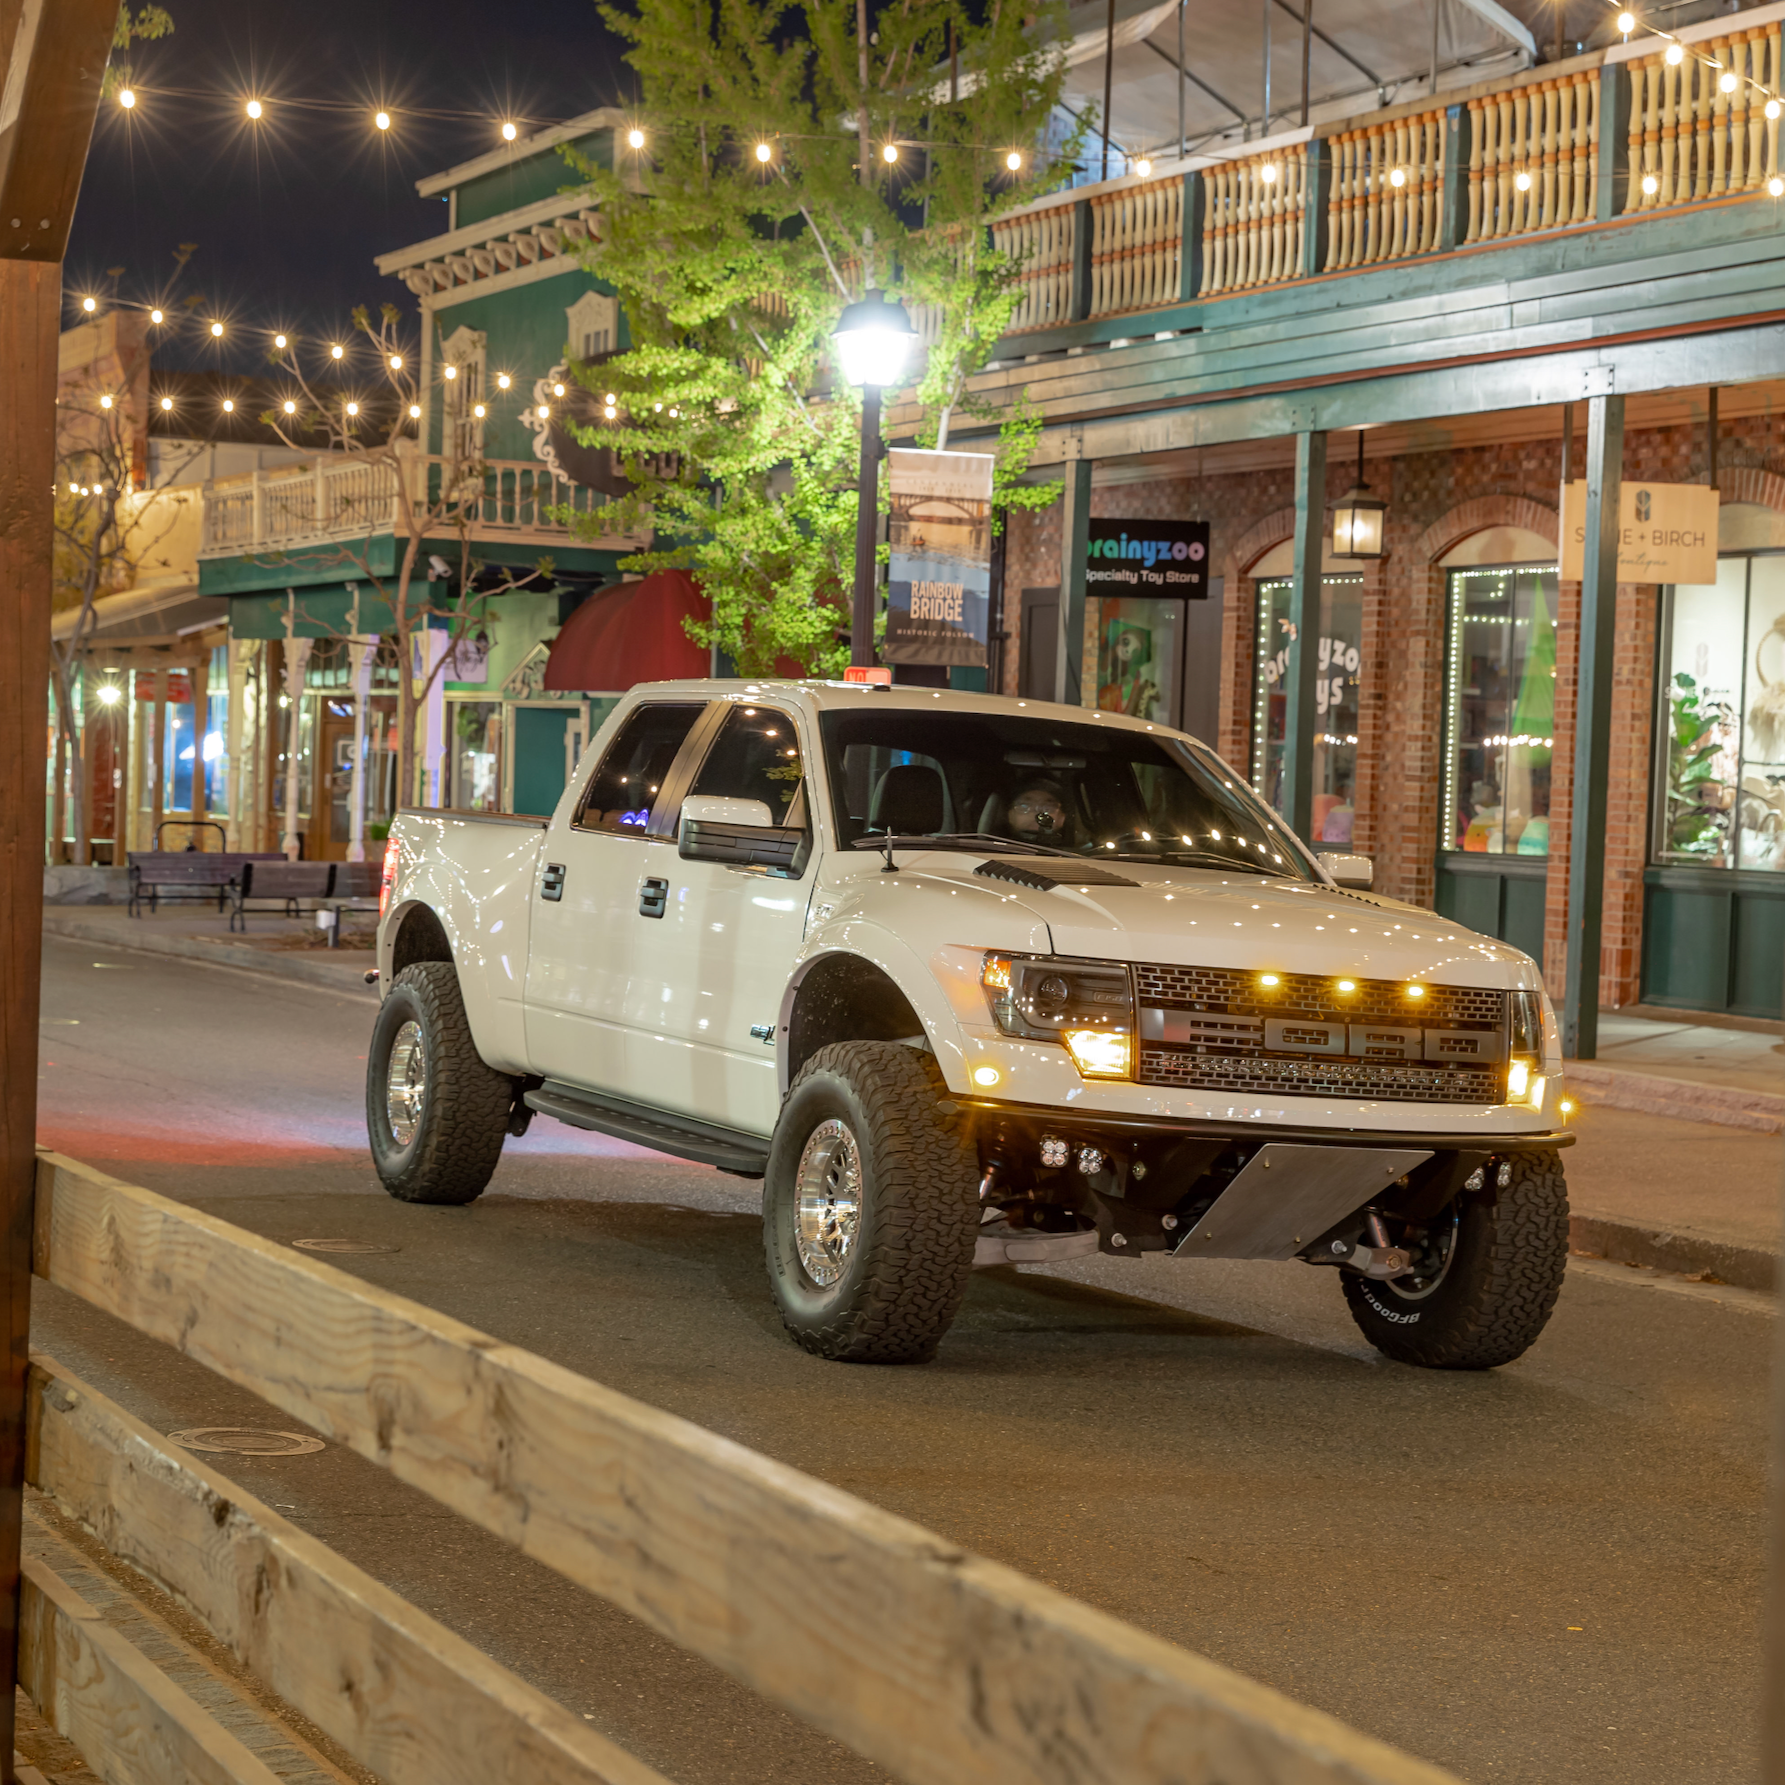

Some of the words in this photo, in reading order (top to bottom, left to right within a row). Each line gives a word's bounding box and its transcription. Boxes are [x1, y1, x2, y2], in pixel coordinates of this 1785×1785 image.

[1652, 529, 1705, 547] BIRCH
[1617, 551, 1668, 574] outique
[1140, 570, 1163, 585] Toy
[1166, 570, 1199, 583] Store
[911, 580, 963, 599] RAINBOW
[910, 597, 963, 621] BRIDGE
[897, 628, 937, 637] HISTORIC
[1316, 677, 1343, 714] ys
[1141, 1007, 1502, 1063] FORD
